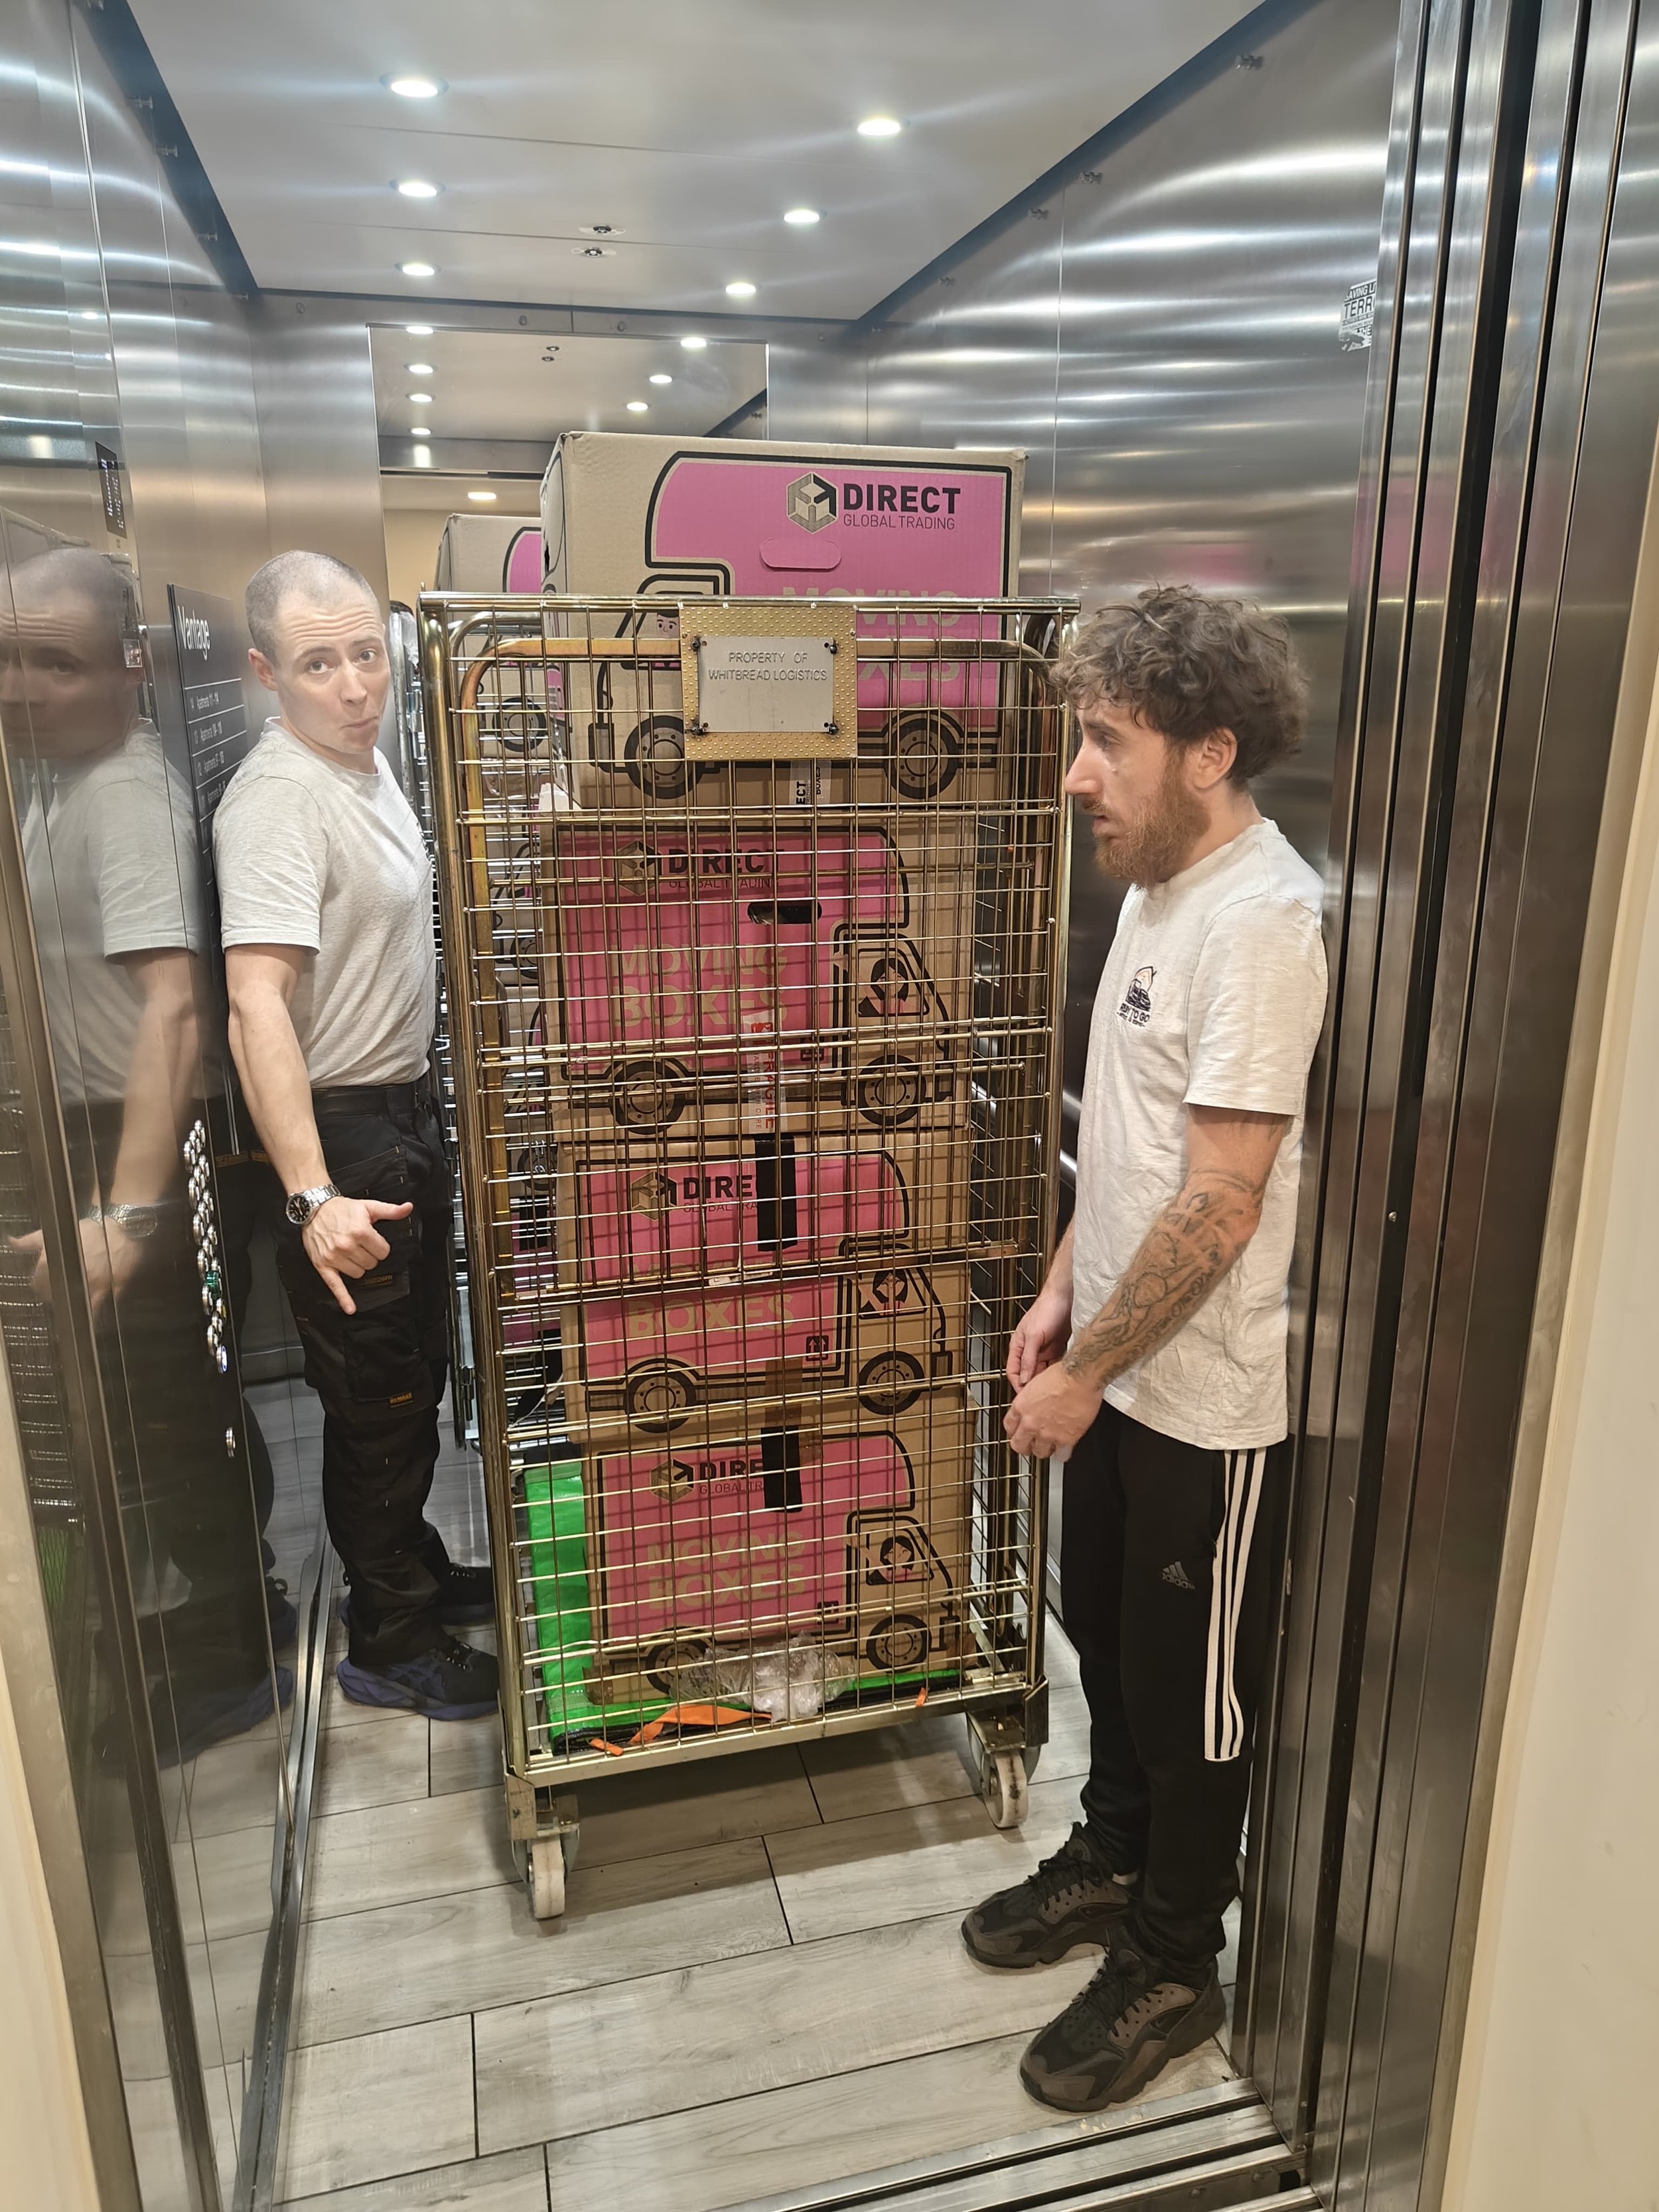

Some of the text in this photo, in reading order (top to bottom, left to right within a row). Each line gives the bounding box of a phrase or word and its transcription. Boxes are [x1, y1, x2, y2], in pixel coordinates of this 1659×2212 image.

[1344, 296, 1375, 319] TERR
[843, 483, 961, 514] DIRECT
[843, 514, 955, 530] GLOBAL TRADING
[177, 605, 210, 660] Vantage
[729, 652, 808, 664] PROPERTY OF
[708, 669, 828, 681] WHITBREAD LOGISTICS
[611, 943, 787, 977] MOVING
[683, 1175, 753, 1200] DIRE
[628, 1293, 795, 1339] BOXES
[699, 1459, 763, 1481] DIRE
[699, 1483, 747, 1495] GLOBAL
[647, 1531, 805, 1570] MOVING
[648, 1564, 806, 1610] BOXES
